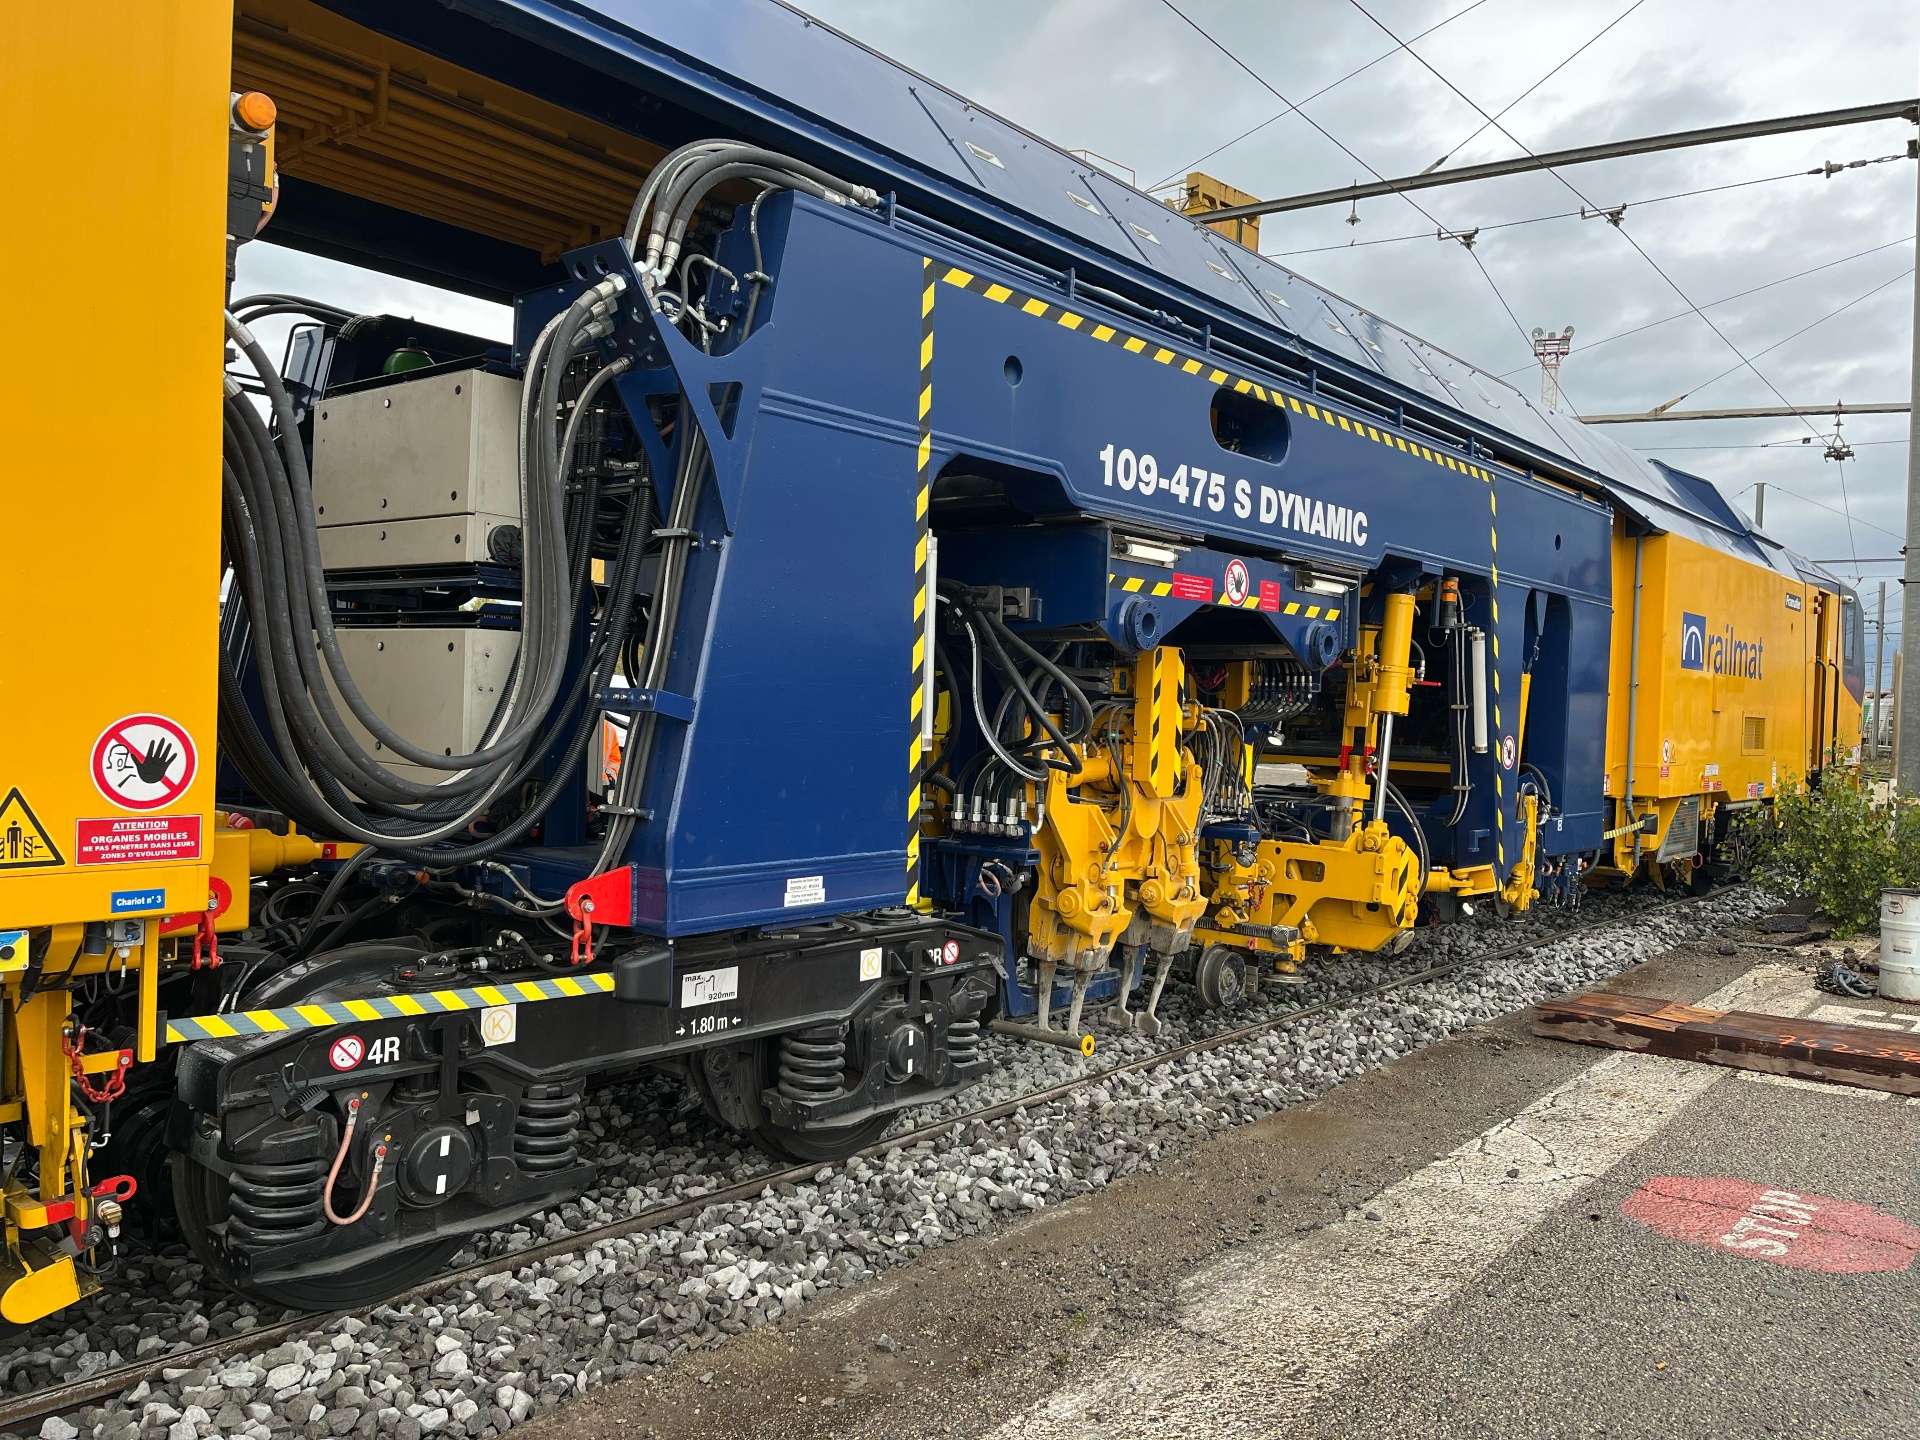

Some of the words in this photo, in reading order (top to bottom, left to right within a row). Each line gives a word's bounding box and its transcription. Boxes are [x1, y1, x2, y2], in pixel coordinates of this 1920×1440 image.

[1100, 444, 1225, 512] 109-475
[1234, 479, 1251, 519] S
[1259, 485, 1368, 546] DYNAMIC
[1707, 624, 1763, 680] railmat
[112, 821, 169, 830] ATTENTION
[91, 834, 140, 844] ORGANES
[144, 832, 188, 841] MOBILES
[111, 843, 148, 851] PENETRER
[128, 849, 177, 858] D'EVOLUTION
[116, 896, 145, 907] Chariot
[156, 895, 162, 904] 3
[685, 975, 704, 983] max.
[708, 991, 735, 1001] 920mm
[690, 1015, 714, 1035] 1.80
[717, 1016, 728, 1030] m
[367, 1036, 400, 1065] 4R
[1720, 1190, 1820, 1256] STOP
